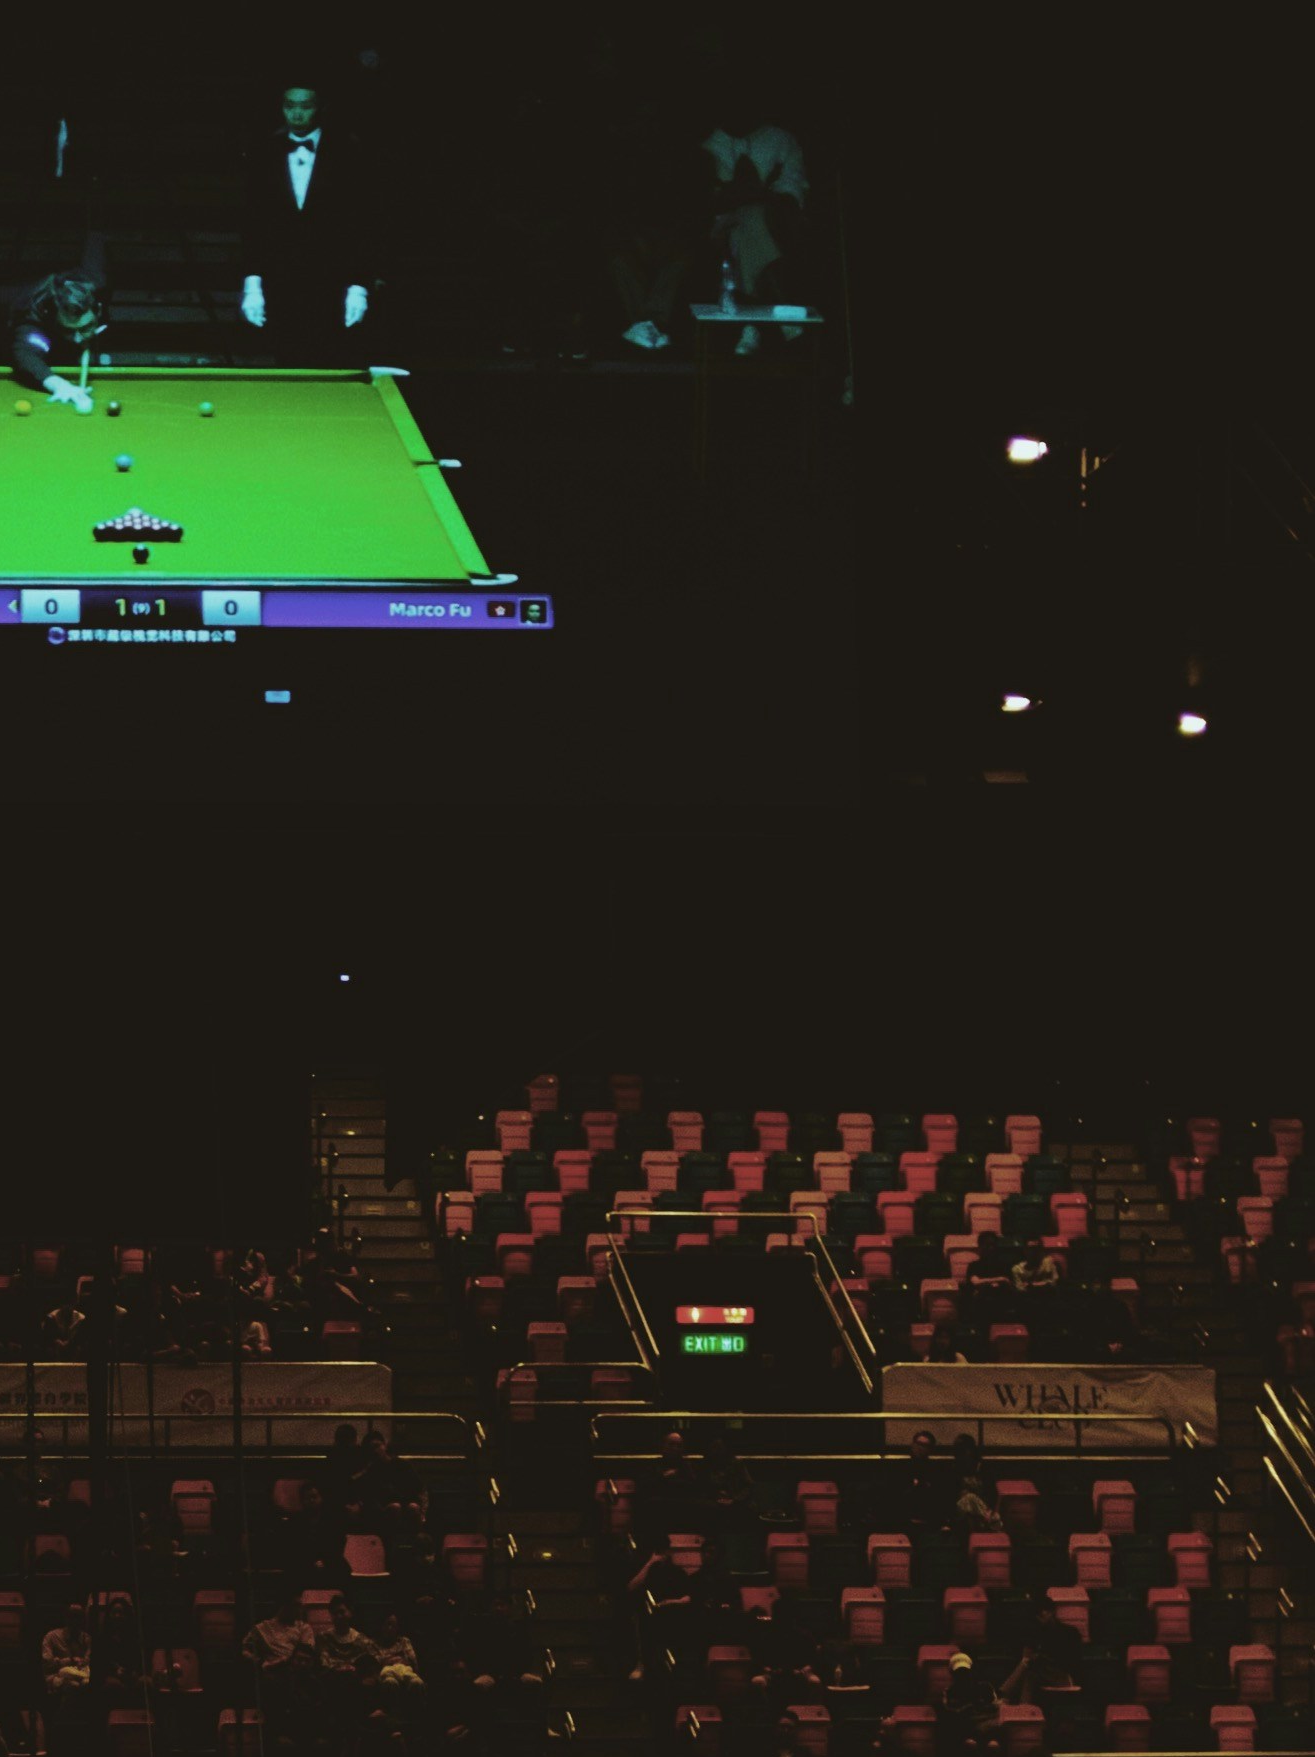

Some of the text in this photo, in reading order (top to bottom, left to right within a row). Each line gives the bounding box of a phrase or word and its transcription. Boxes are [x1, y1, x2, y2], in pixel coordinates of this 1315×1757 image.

[45, 598, 58, 615] 0
[115, 598, 126, 617] 1
[155, 598, 166, 617] 1
[224, 600, 238, 616] 0
[389, 602, 472, 617] Marco Fu
[684, 1336, 745, 1353] EXIT 出口
[994, 1383, 1108, 1411] WHALE
